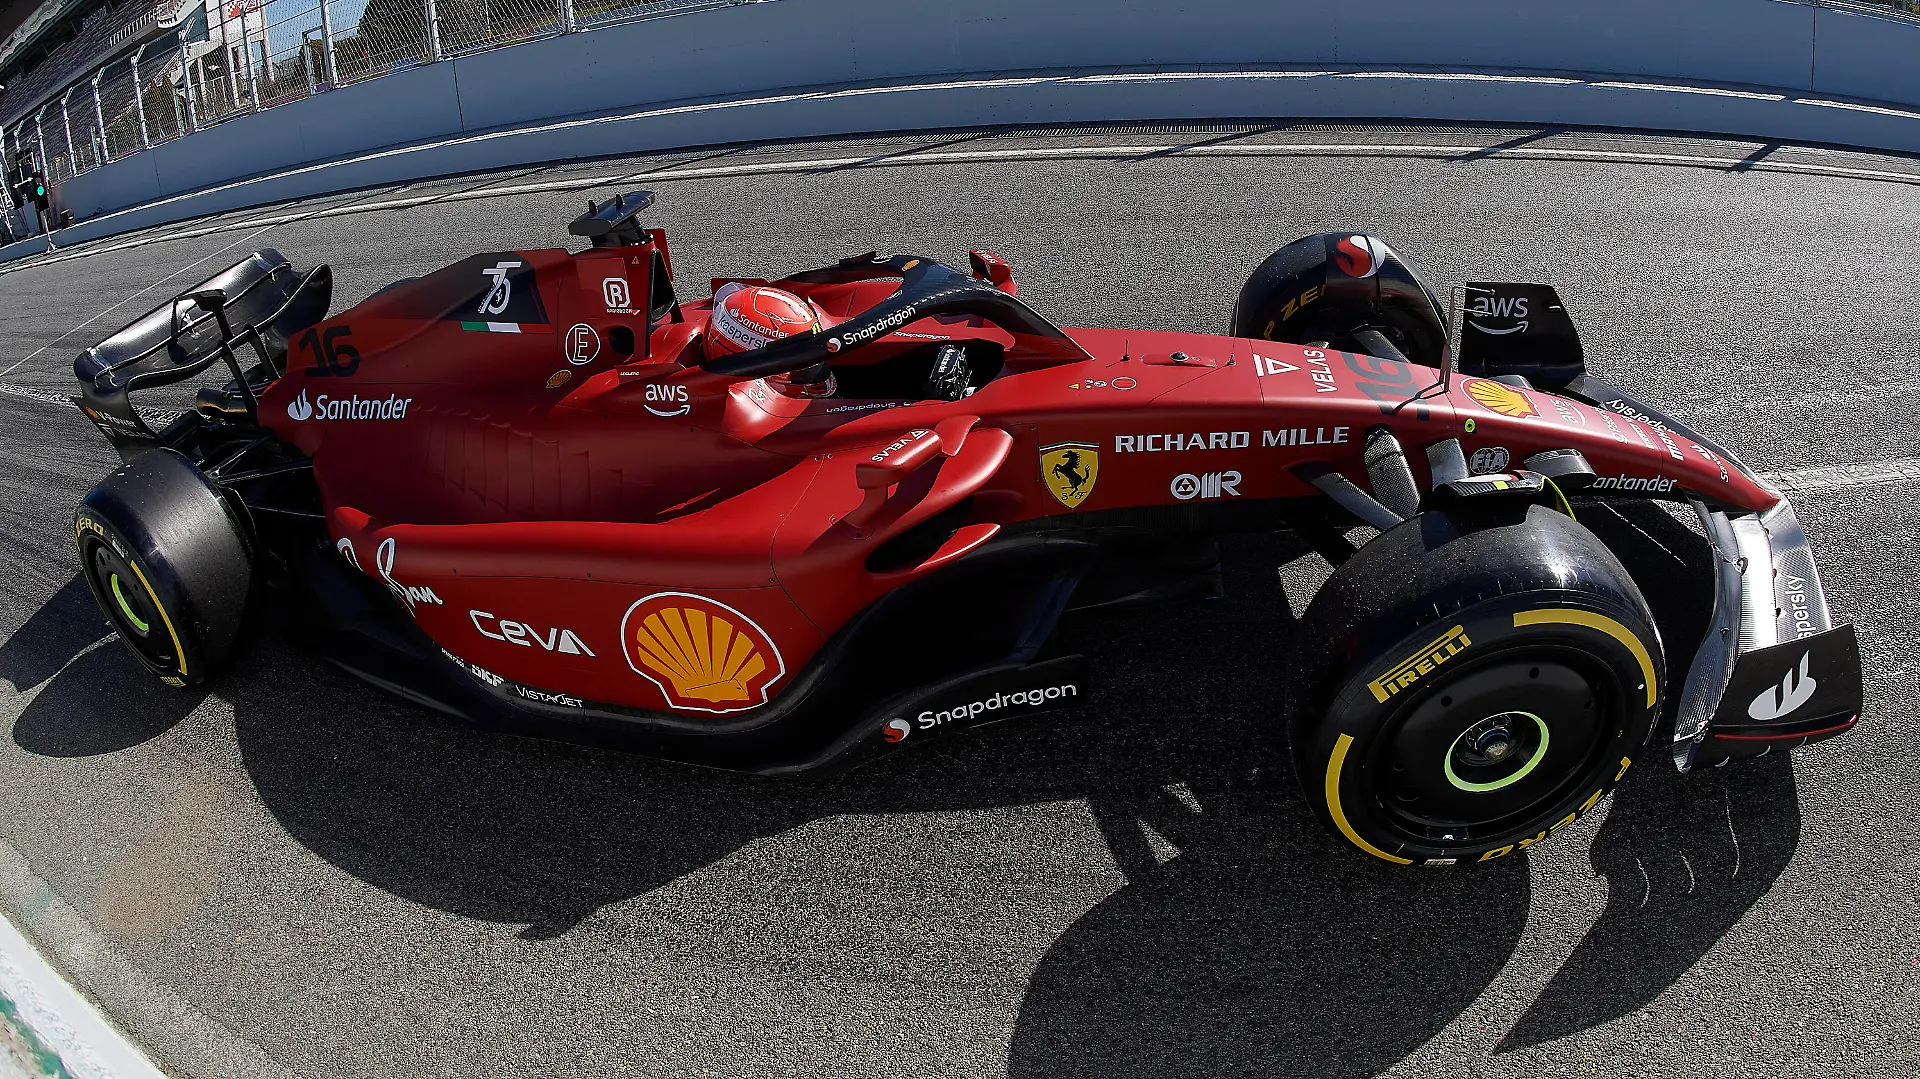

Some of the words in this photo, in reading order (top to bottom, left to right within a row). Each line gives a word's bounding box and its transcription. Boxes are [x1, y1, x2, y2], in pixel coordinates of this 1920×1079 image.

[717, 314, 767, 349] kaspers
[738, 314, 790, 340] Santander
[843, 306, 916, 345] Snapdragon
[298, 325, 361, 378] 16
[1303, 349, 1338, 393] VELAS
[645, 383, 689, 402] aws
[315, 393, 412, 421] Santander
[826, 402, 896, 413] Snapdragon
[871, 438, 913, 462] VELAS
[1115, 430, 1250, 454] RICHARD
[1261, 426, 1350, 448] MILLE
[1583, 473, 1678, 492] antander
[1366, 624, 1472, 704] PIRELLI
[917, 684, 1077, 730] Snapdragon
